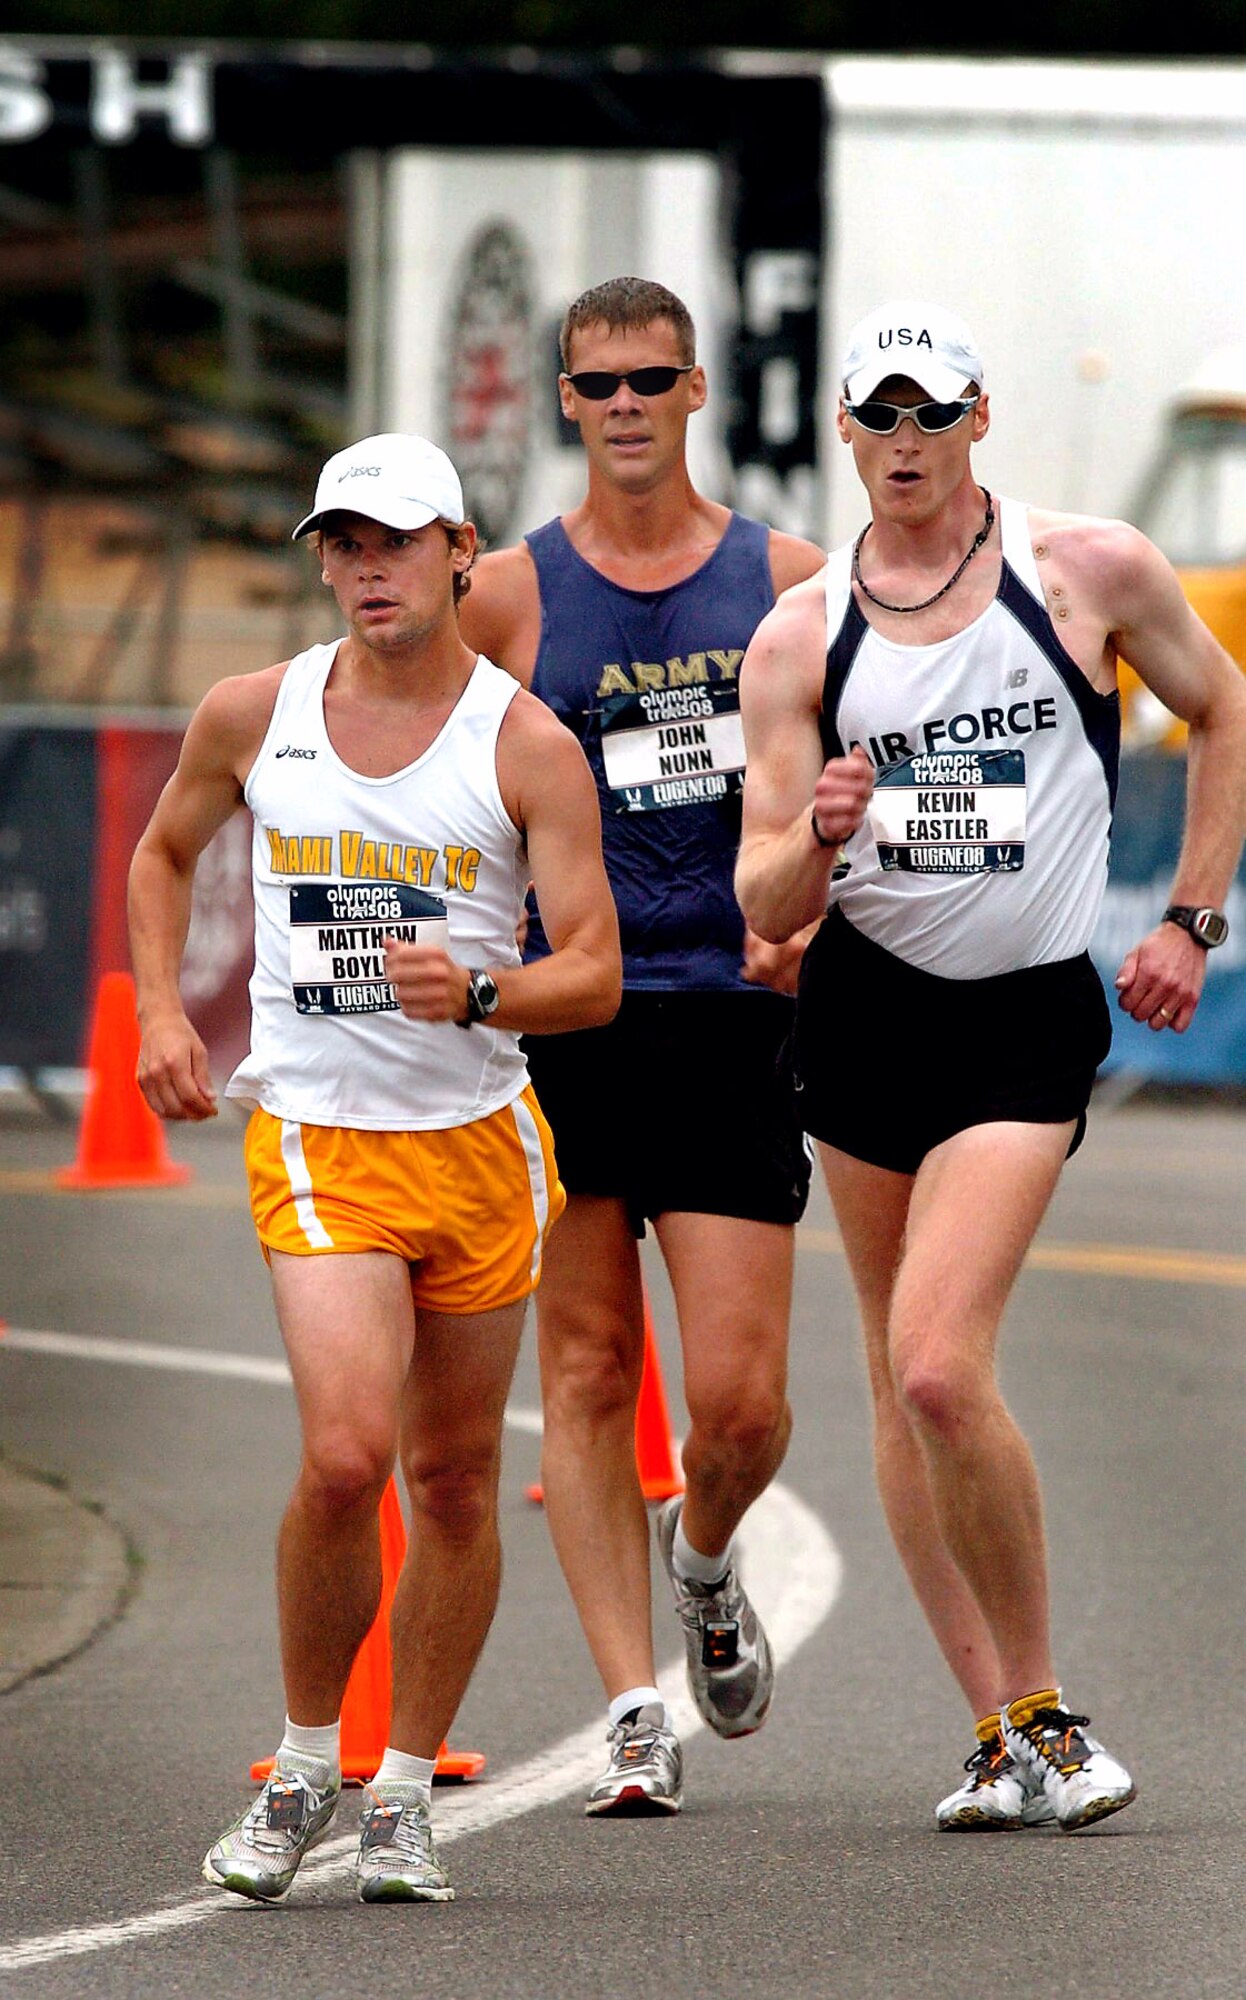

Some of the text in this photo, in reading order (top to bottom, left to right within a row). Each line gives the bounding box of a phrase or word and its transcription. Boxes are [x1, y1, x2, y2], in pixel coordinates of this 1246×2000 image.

[878, 328, 933, 349] USA
[597, 650, 744, 698] ARMY
[639, 686, 707, 709] olympic
[923, 697, 1057, 752] FORCE
[657, 723, 706, 750] JOHN
[659, 749, 713, 776] NUNN
[910, 754, 979, 772] olympic
[652, 774, 727, 804] EUGENE08
[917, 792, 976, 813] KEVIN
[906, 818, 988, 841] EASTLER
[340, 830, 438, 886] VALLEY
[443, 844, 481, 892] TC
[909, 846, 985, 867] EUGENE08
[327, 885, 398, 906] olympic
[332, 955, 387, 979] BOYL
[340, 1004, 380, 1013] HAYWARD
